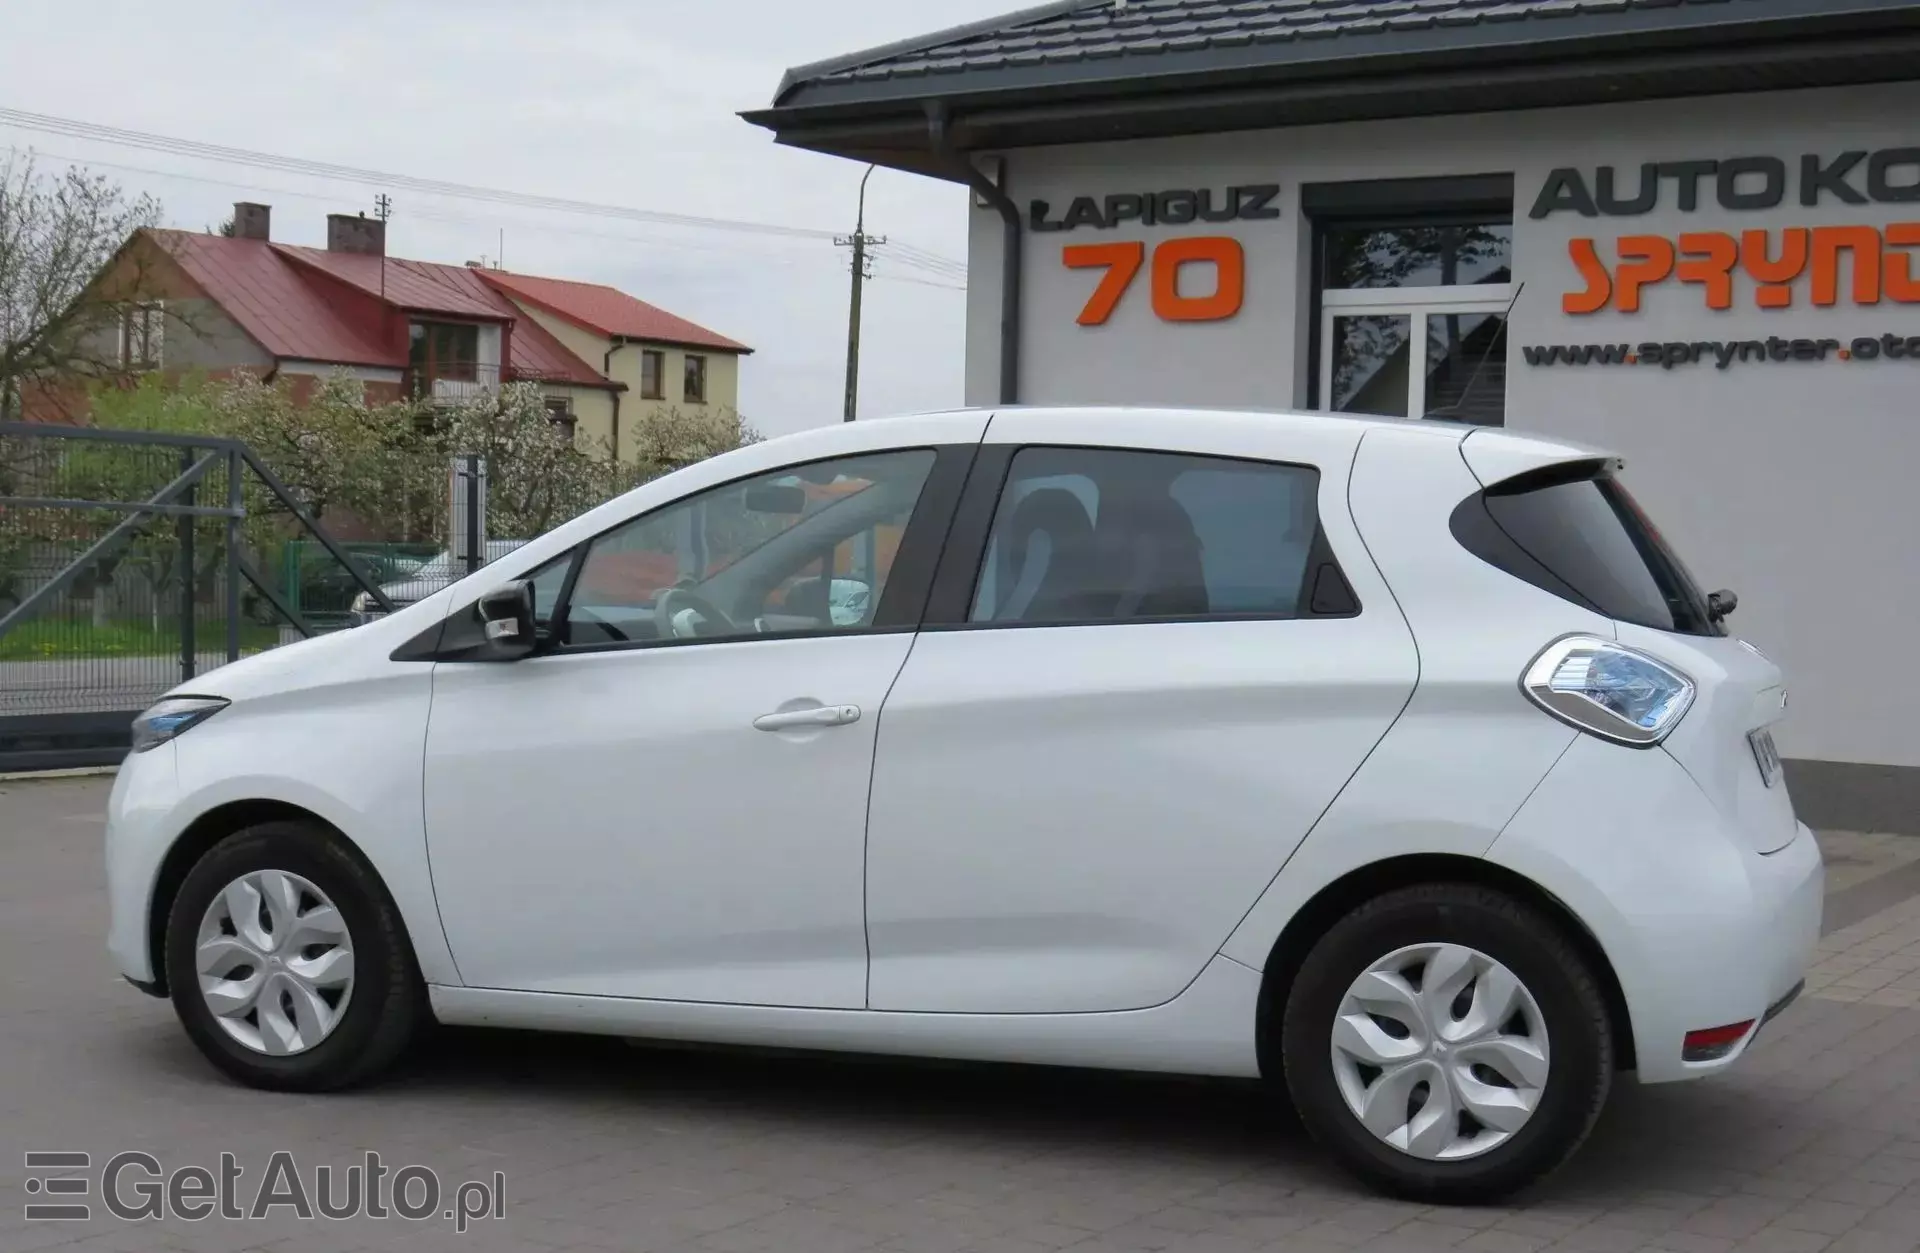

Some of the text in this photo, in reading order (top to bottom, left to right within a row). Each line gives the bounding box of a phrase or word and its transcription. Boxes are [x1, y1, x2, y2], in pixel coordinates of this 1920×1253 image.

[1030, 184, 1280, 232] ŁAPIGUZ
[1528, 147, 1920, 219] AUTO KO
[1062, 236, 1245, 326] 70
